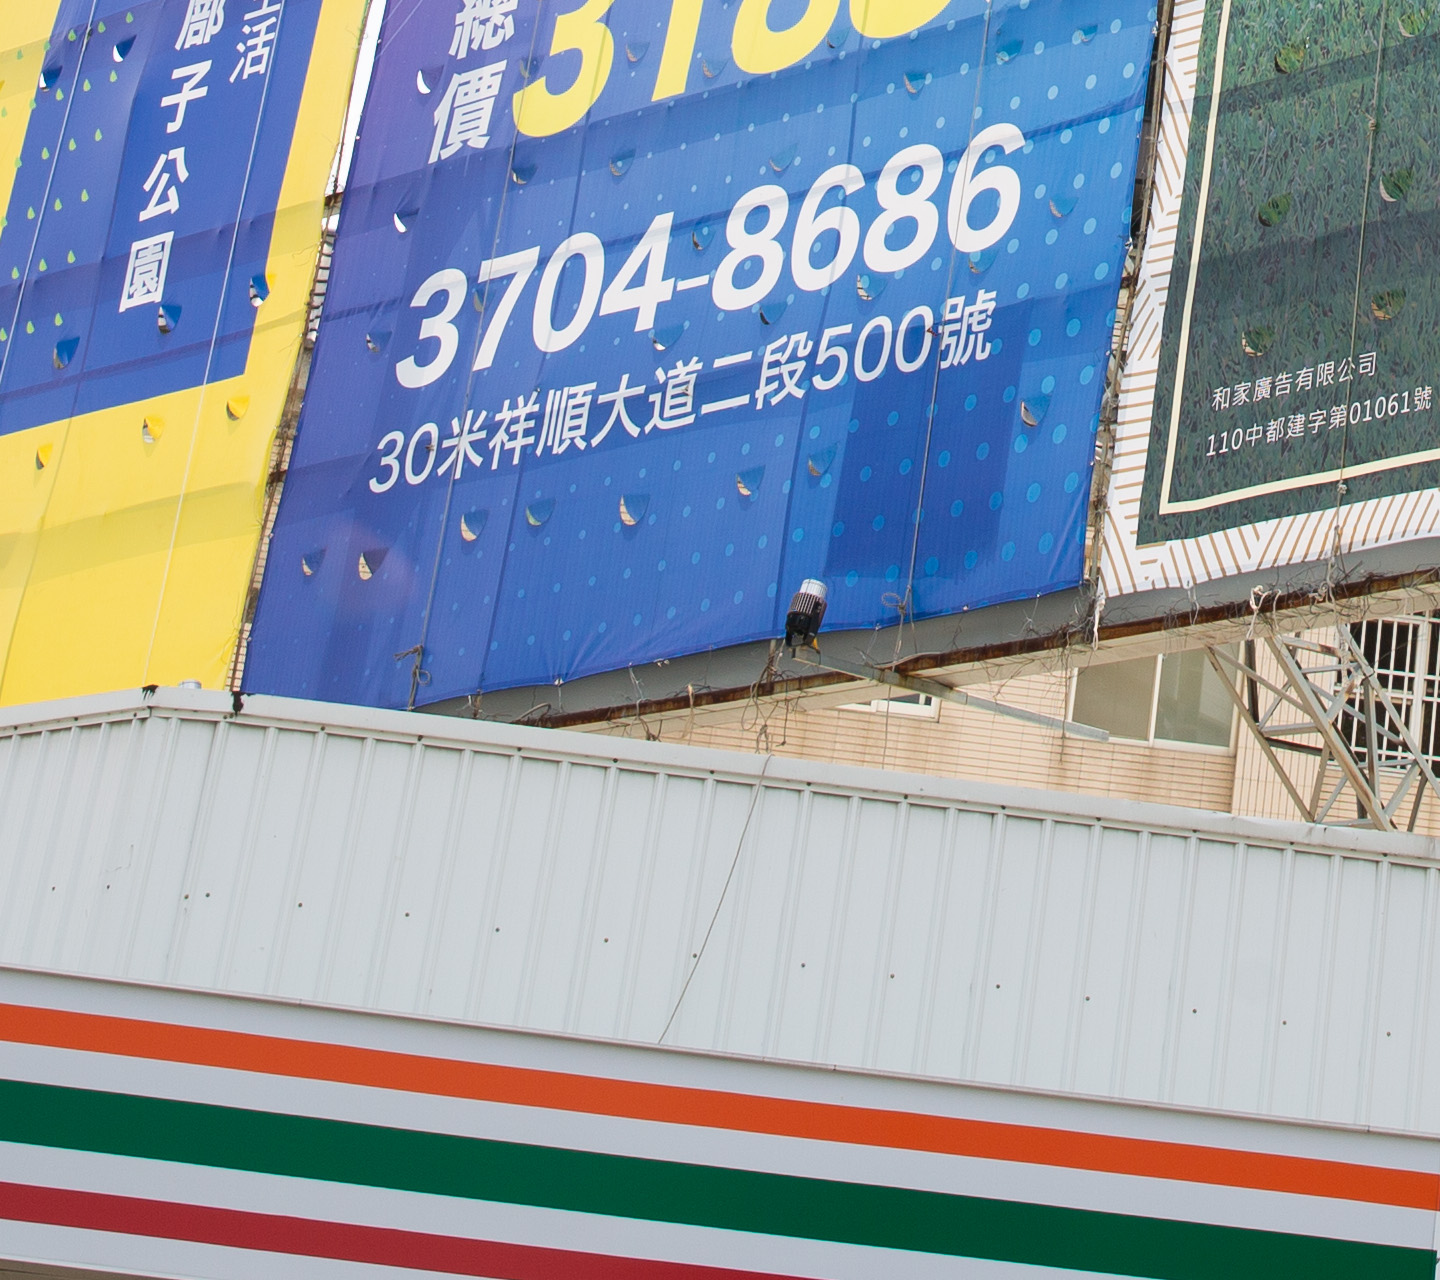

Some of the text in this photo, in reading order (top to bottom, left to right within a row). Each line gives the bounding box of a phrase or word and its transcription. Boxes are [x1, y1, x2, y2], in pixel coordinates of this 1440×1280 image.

[395, 122, 1026, 389] 3704-8686
[368, 288, 998, 495] 30米祥順大道二段500號
[1206, 385, 1433, 457] 110中都建字第01061號
[1211, 351, 1377, 412] 和家廣告有限公司
